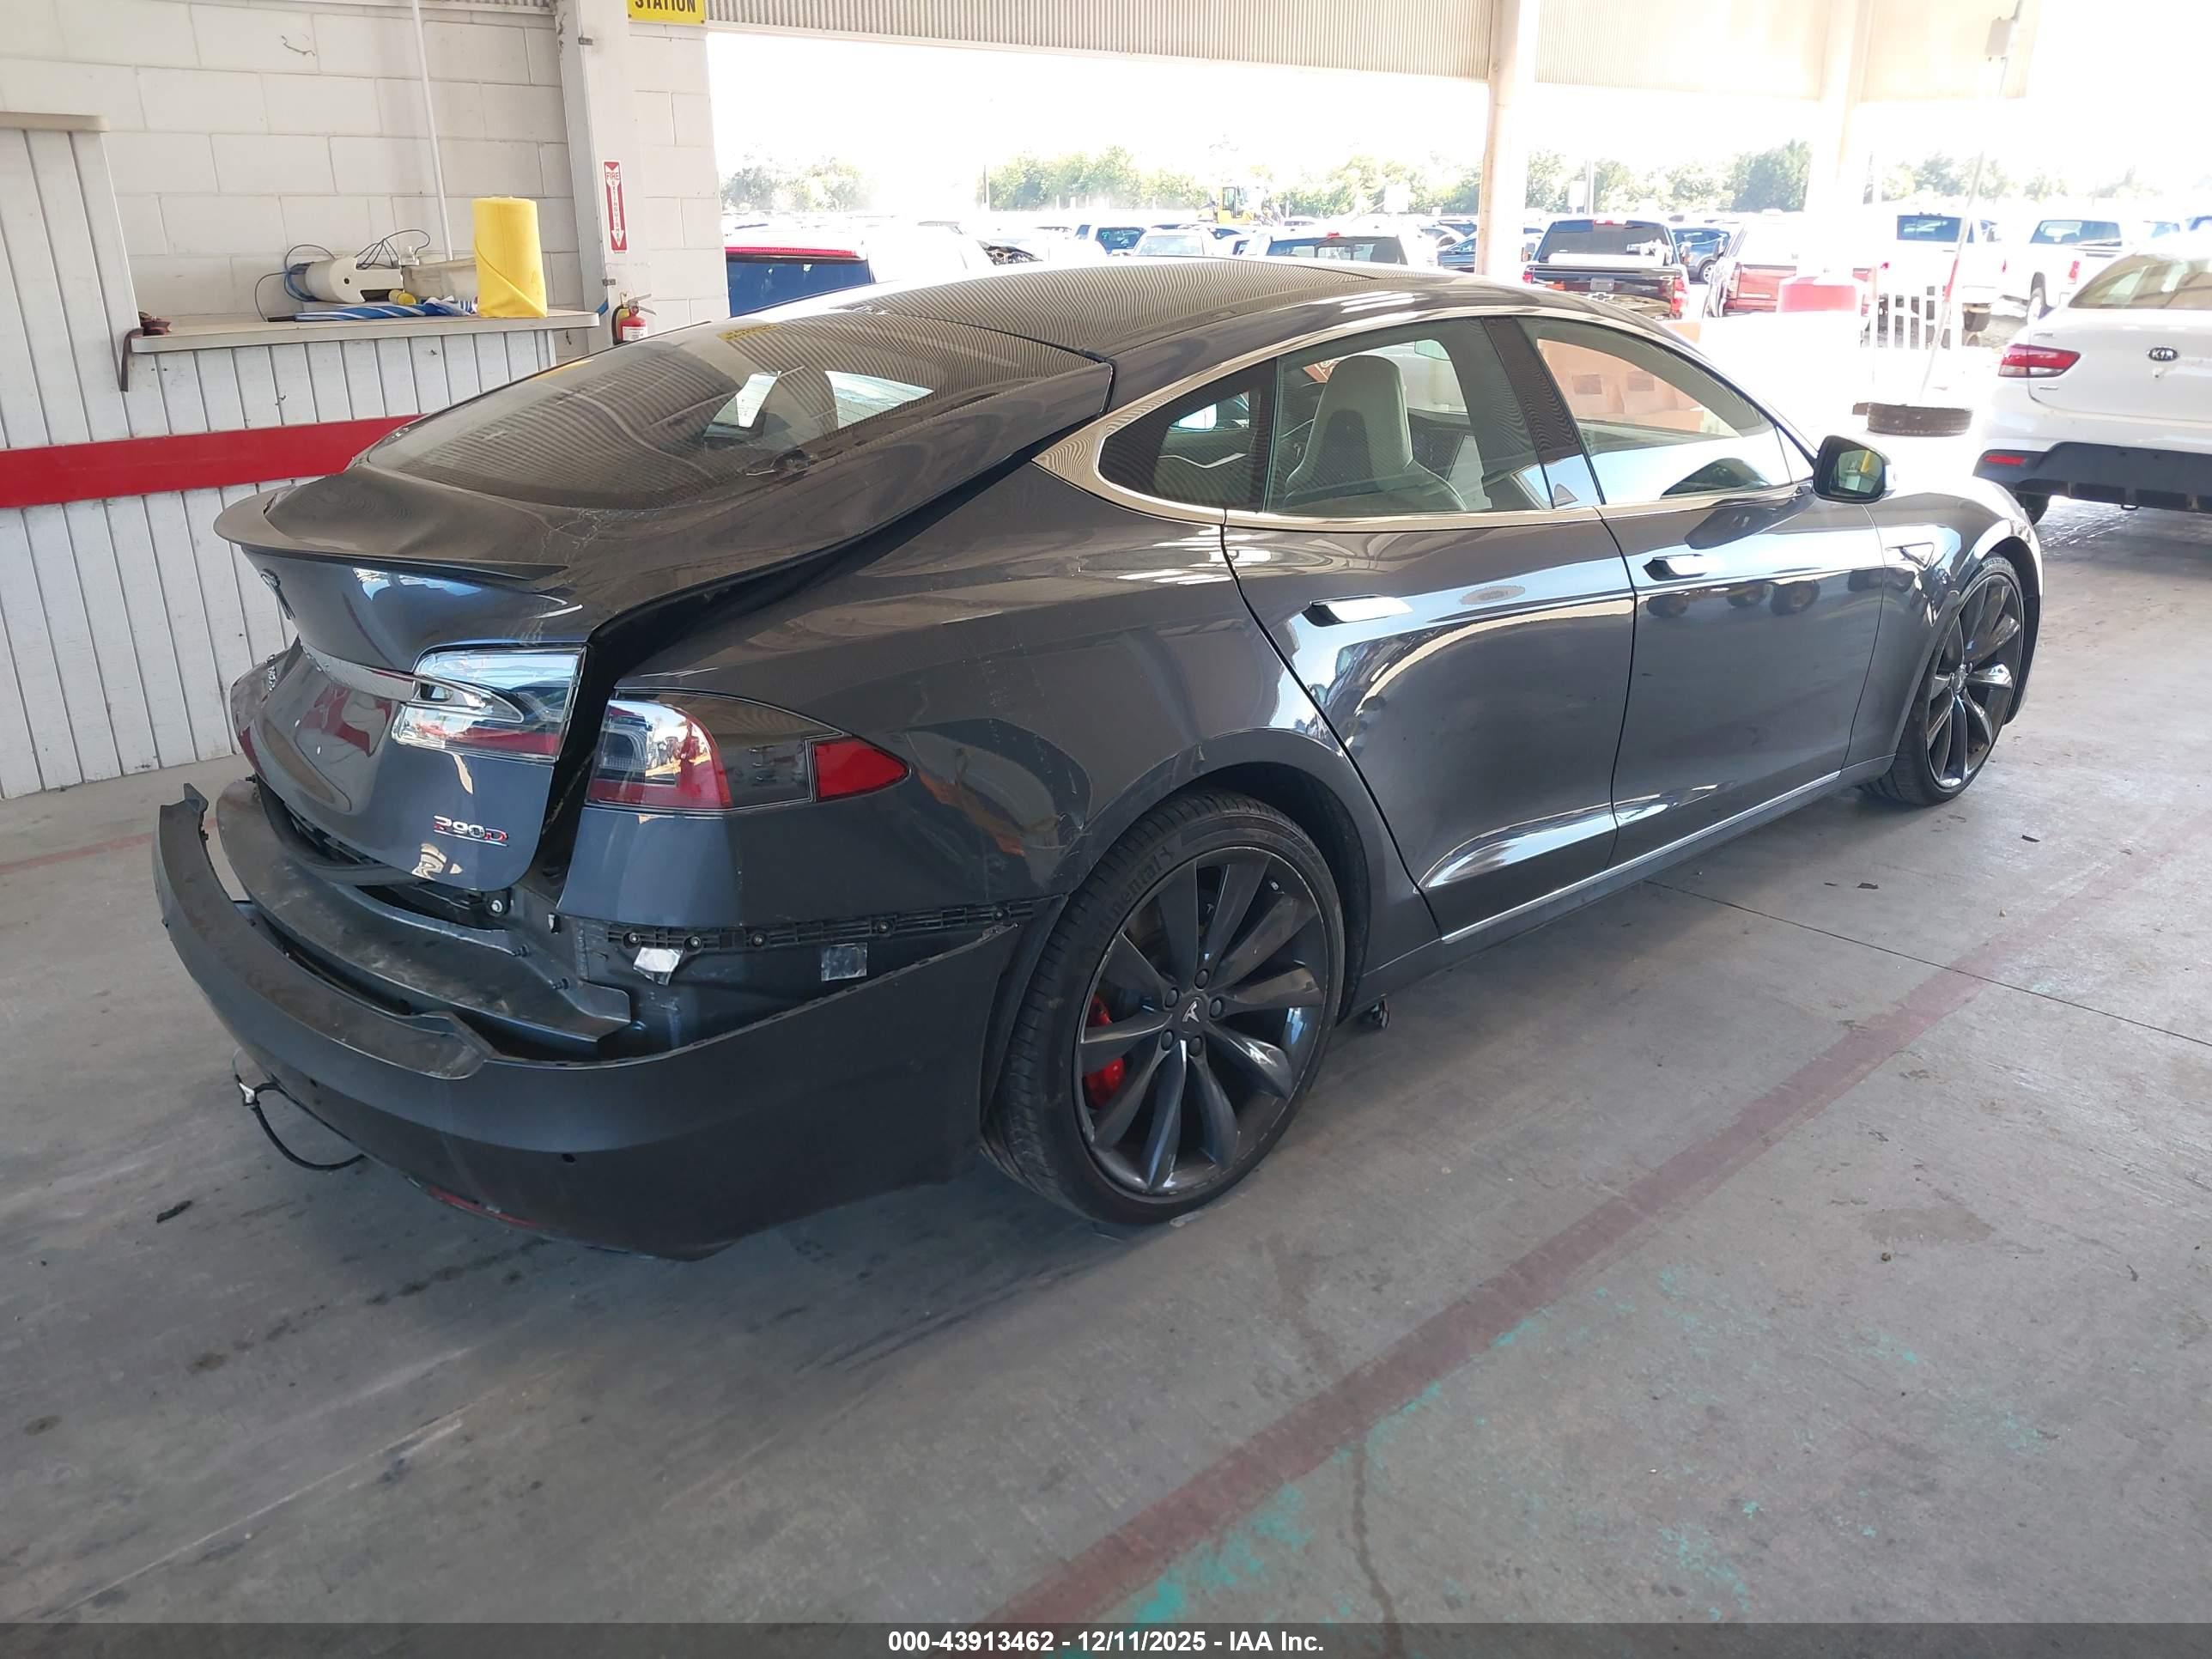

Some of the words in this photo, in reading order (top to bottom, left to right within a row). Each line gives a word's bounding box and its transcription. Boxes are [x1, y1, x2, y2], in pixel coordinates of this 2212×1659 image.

[635, 0, 696, 13] STATION
[605, 172, 620, 180] FIRE
[611, 180, 621, 242] EXTINGUISHER
[2151, 349, 2175, 360] KIA
[433, 815, 508, 842] P90D
